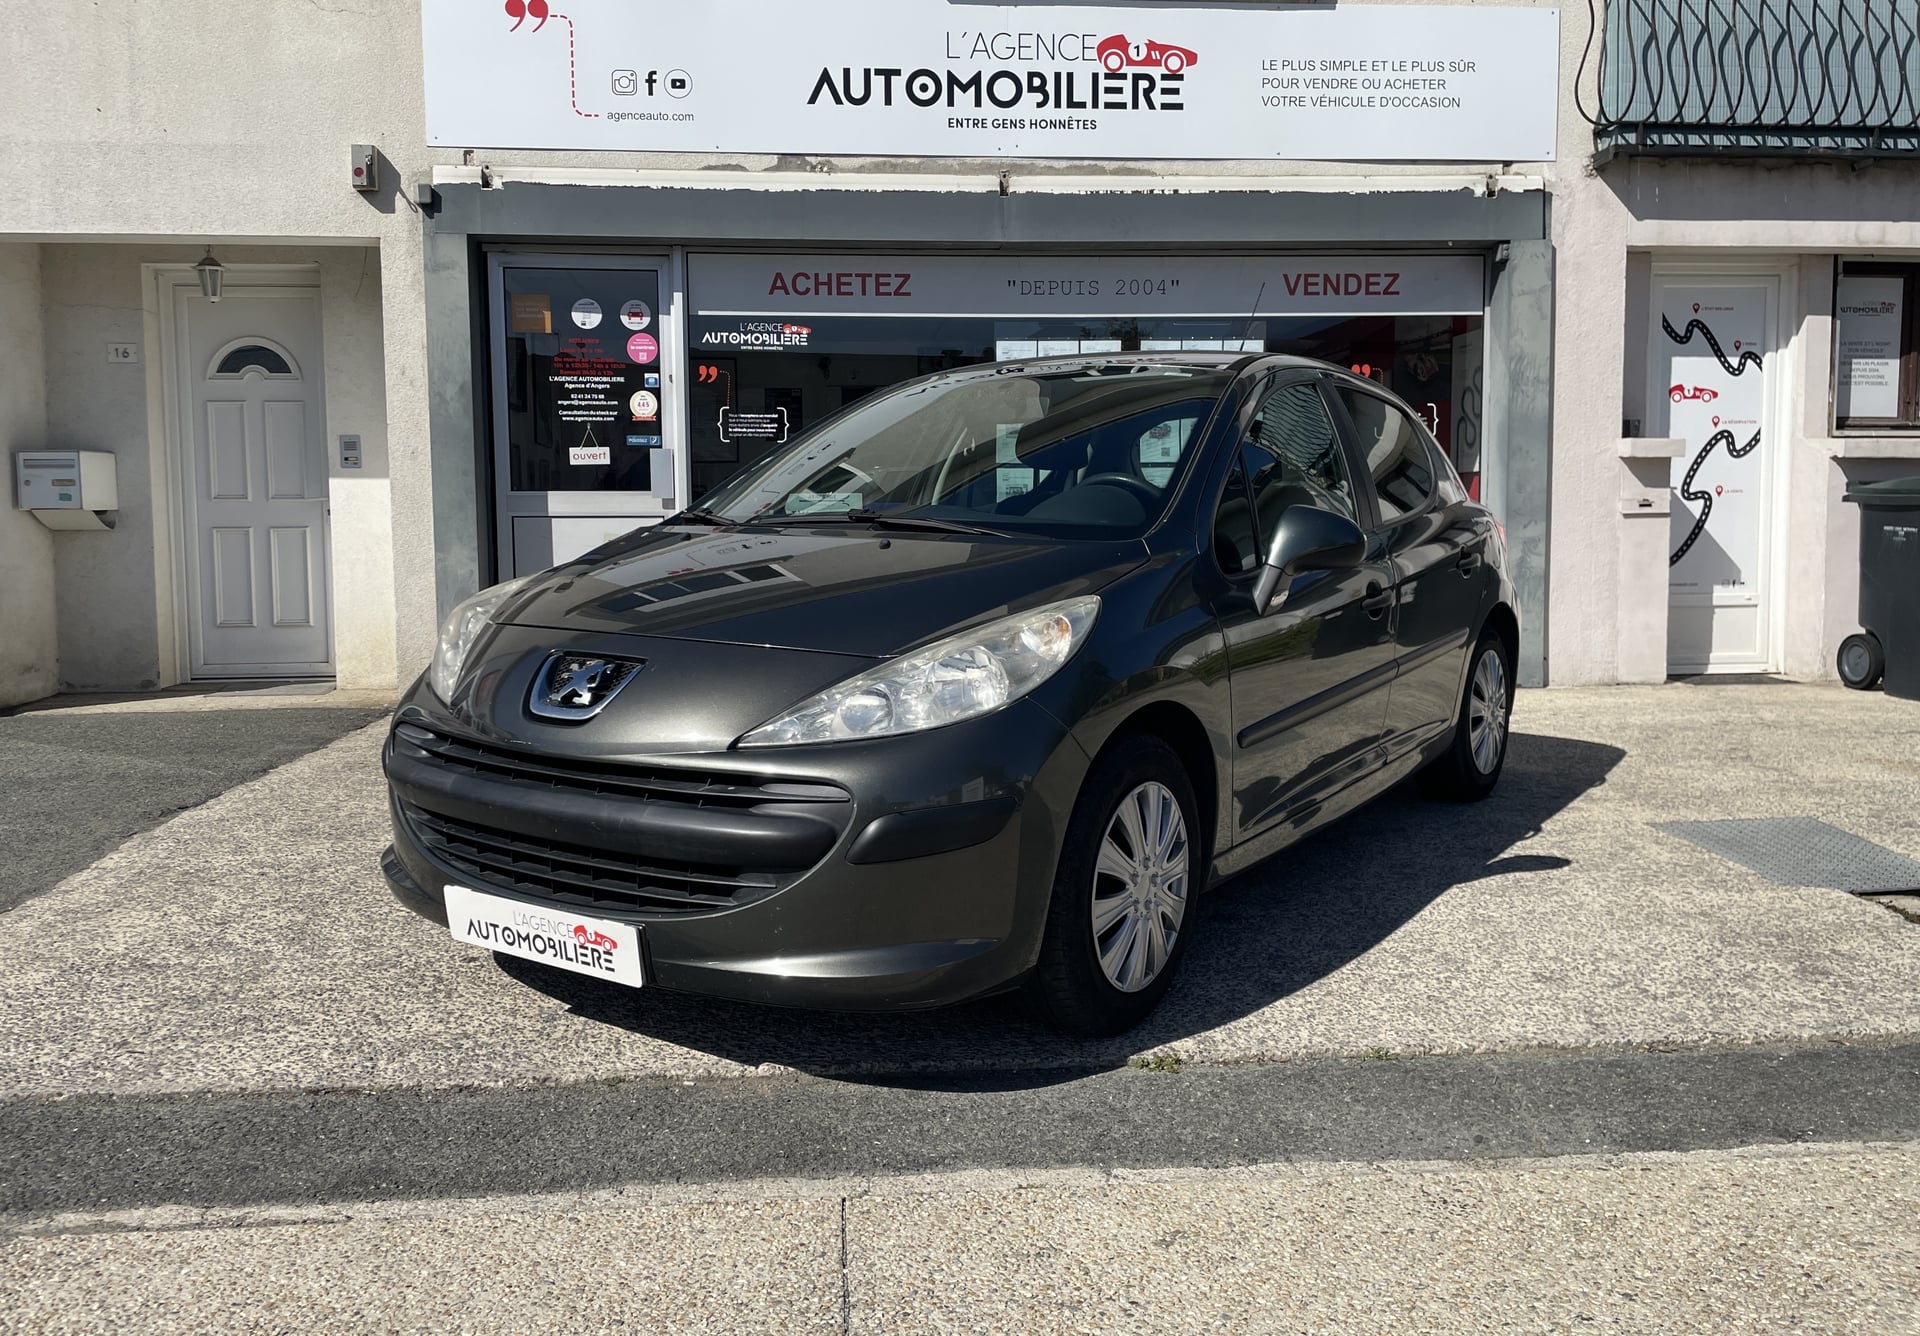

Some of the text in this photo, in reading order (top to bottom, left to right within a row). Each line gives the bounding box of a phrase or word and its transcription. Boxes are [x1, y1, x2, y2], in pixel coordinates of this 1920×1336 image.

[946, 31, 1097, 62] L'AGENCE
[1133, 45, 1142, 57] 1
[1262, 58, 1476, 73] LE PLUS SIMPLE ET LE PLUS SÛR
[1262, 77, 1447, 90] POUR VENDRE OU ACHETER
[1261, 94, 1461, 108] VOTRE VÉHICULE D'OCCASION
[607, 111, 695, 123] agenceauto.com
[947, 115, 1097, 130] ENTRE GENS HONNÊTES
[768, 271, 1401, 297] ACHETEZ "DEPUIS 2004" VENDEZ
[740, 322, 783, 332] L'AGENCE
[115, 347, 130, 359] 16
[564, 382, 611, 390] Agence d'Angers
[572, 451, 607, 461] ouvert
[512, 910, 576, 940] L'AGENCE
